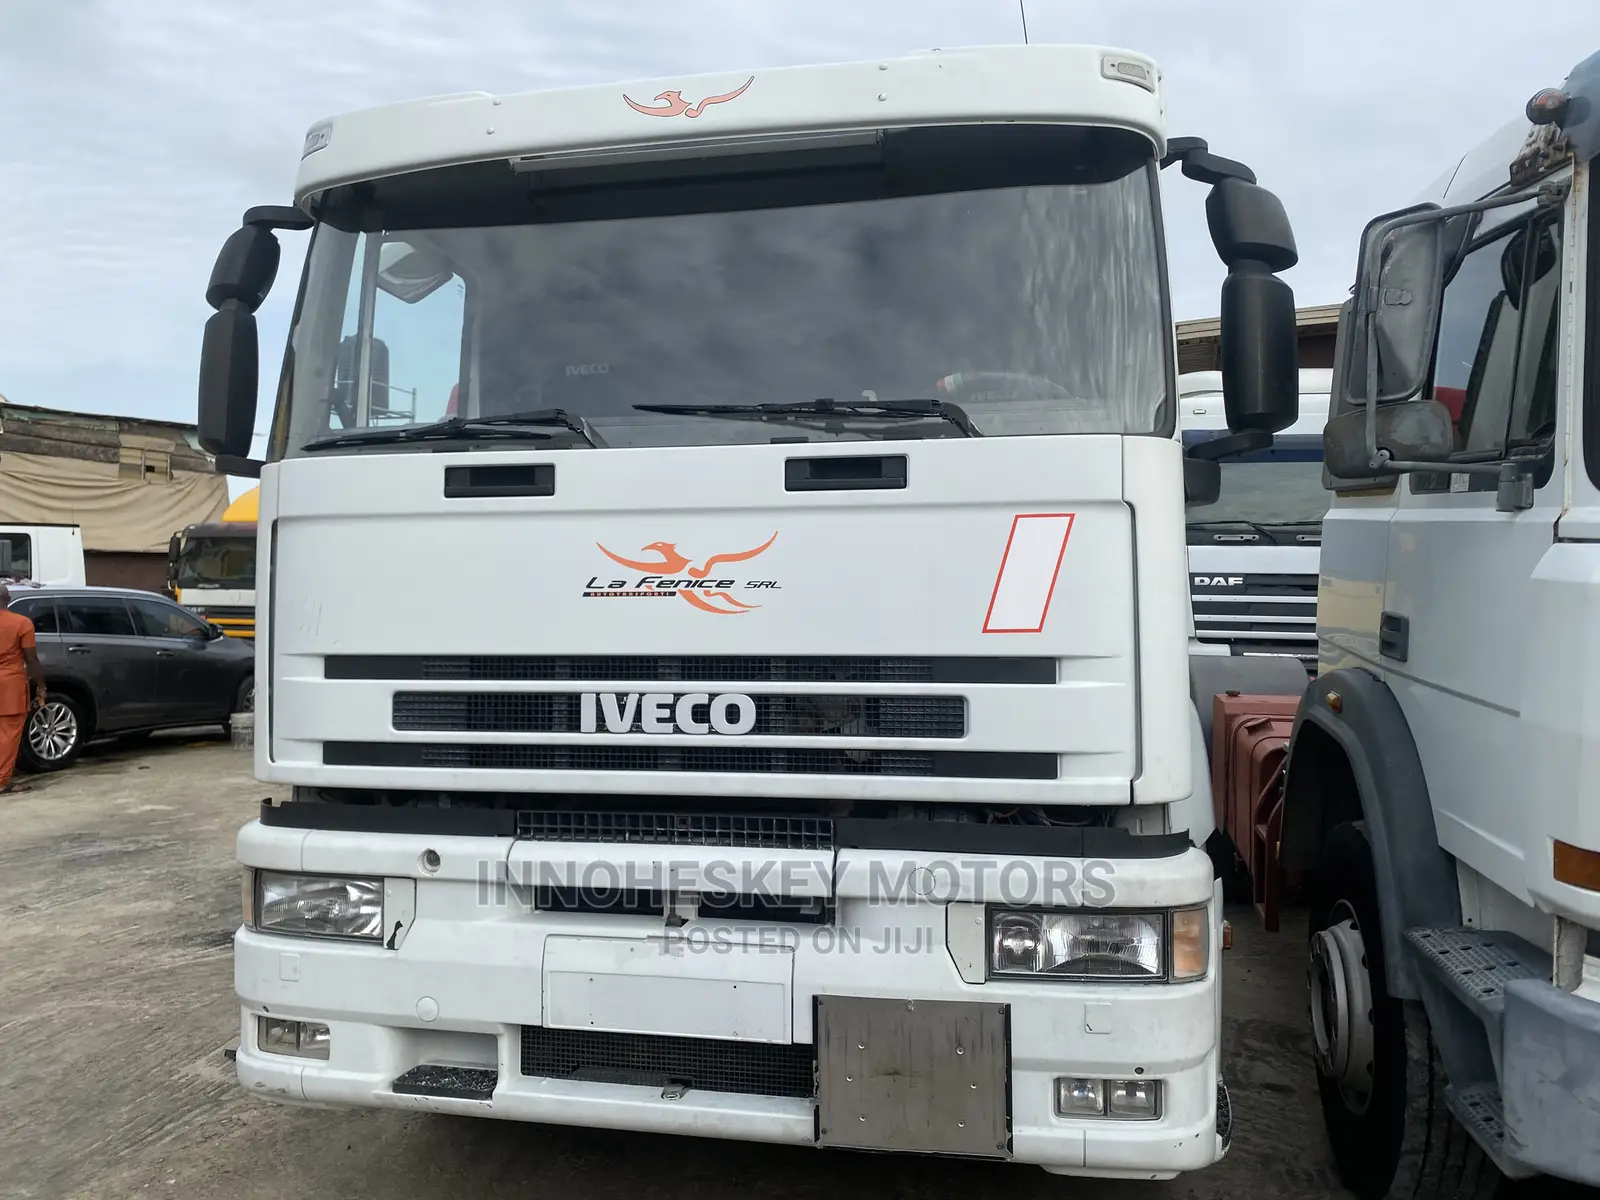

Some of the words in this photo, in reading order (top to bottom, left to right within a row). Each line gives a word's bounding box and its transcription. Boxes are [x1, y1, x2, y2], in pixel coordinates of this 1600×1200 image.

[585, 576, 627, 589] La
[635, 576, 735, 589] Fenice
[744, 580, 782, 589] SRL
[1194, 577, 1243, 586] DAF
[580, 693, 757, 735] IVECO
